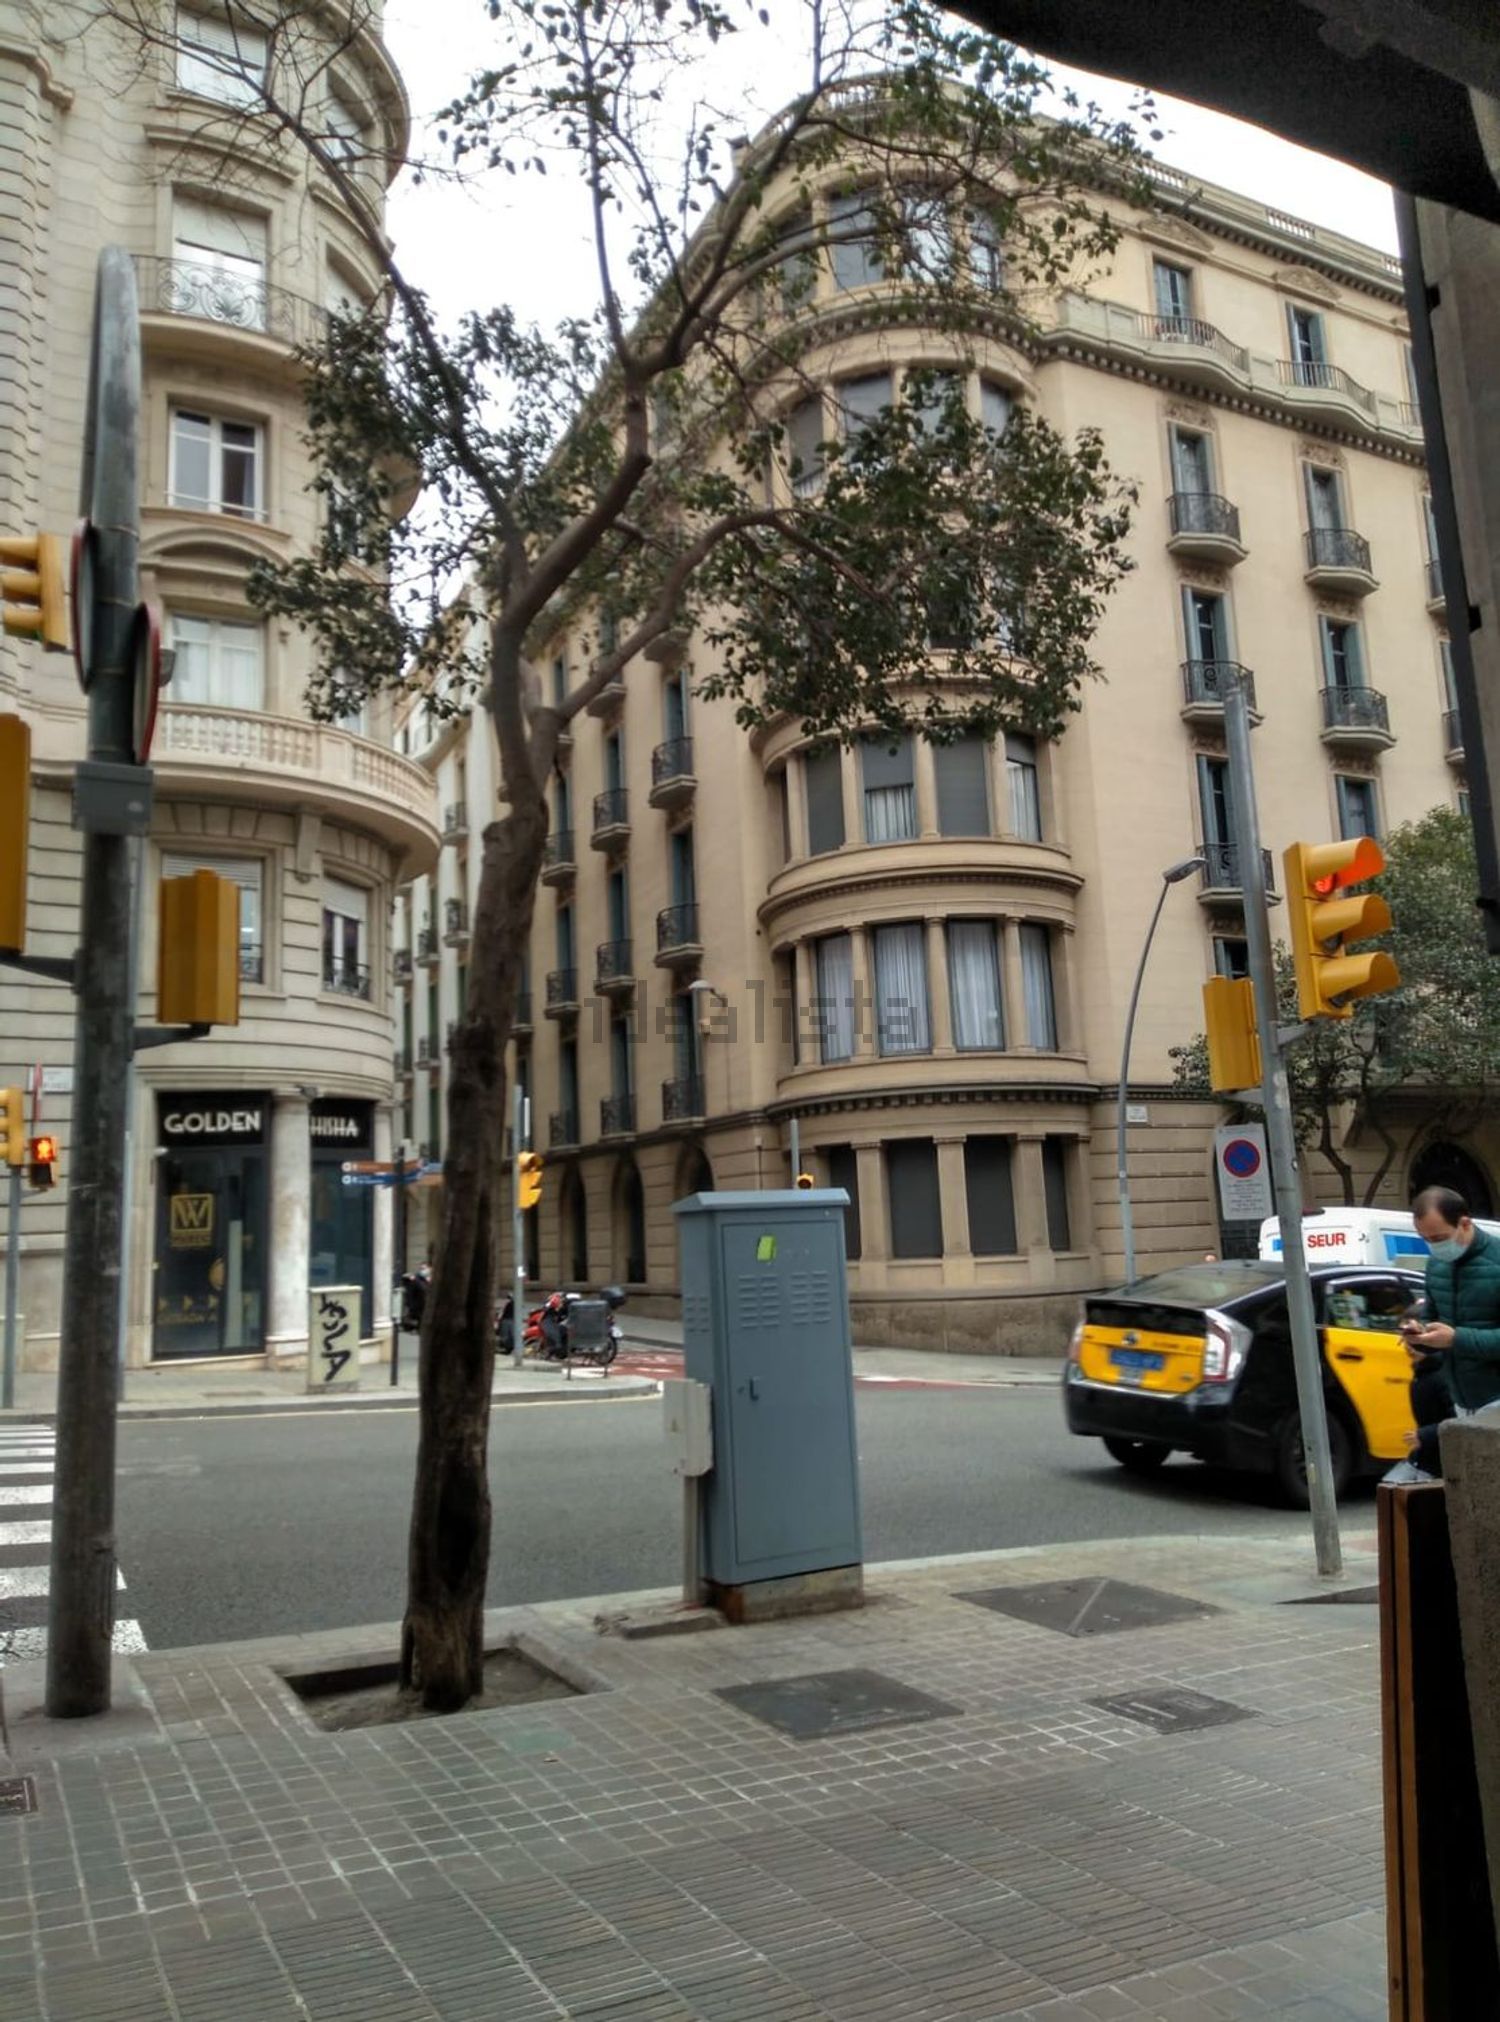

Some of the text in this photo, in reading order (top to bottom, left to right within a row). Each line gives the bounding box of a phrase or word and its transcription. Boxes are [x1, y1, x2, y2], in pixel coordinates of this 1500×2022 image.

[164, 1110, 359, 1138] GOLDEN HISHA
[1307, 1232, 1346, 1248] SEUR
